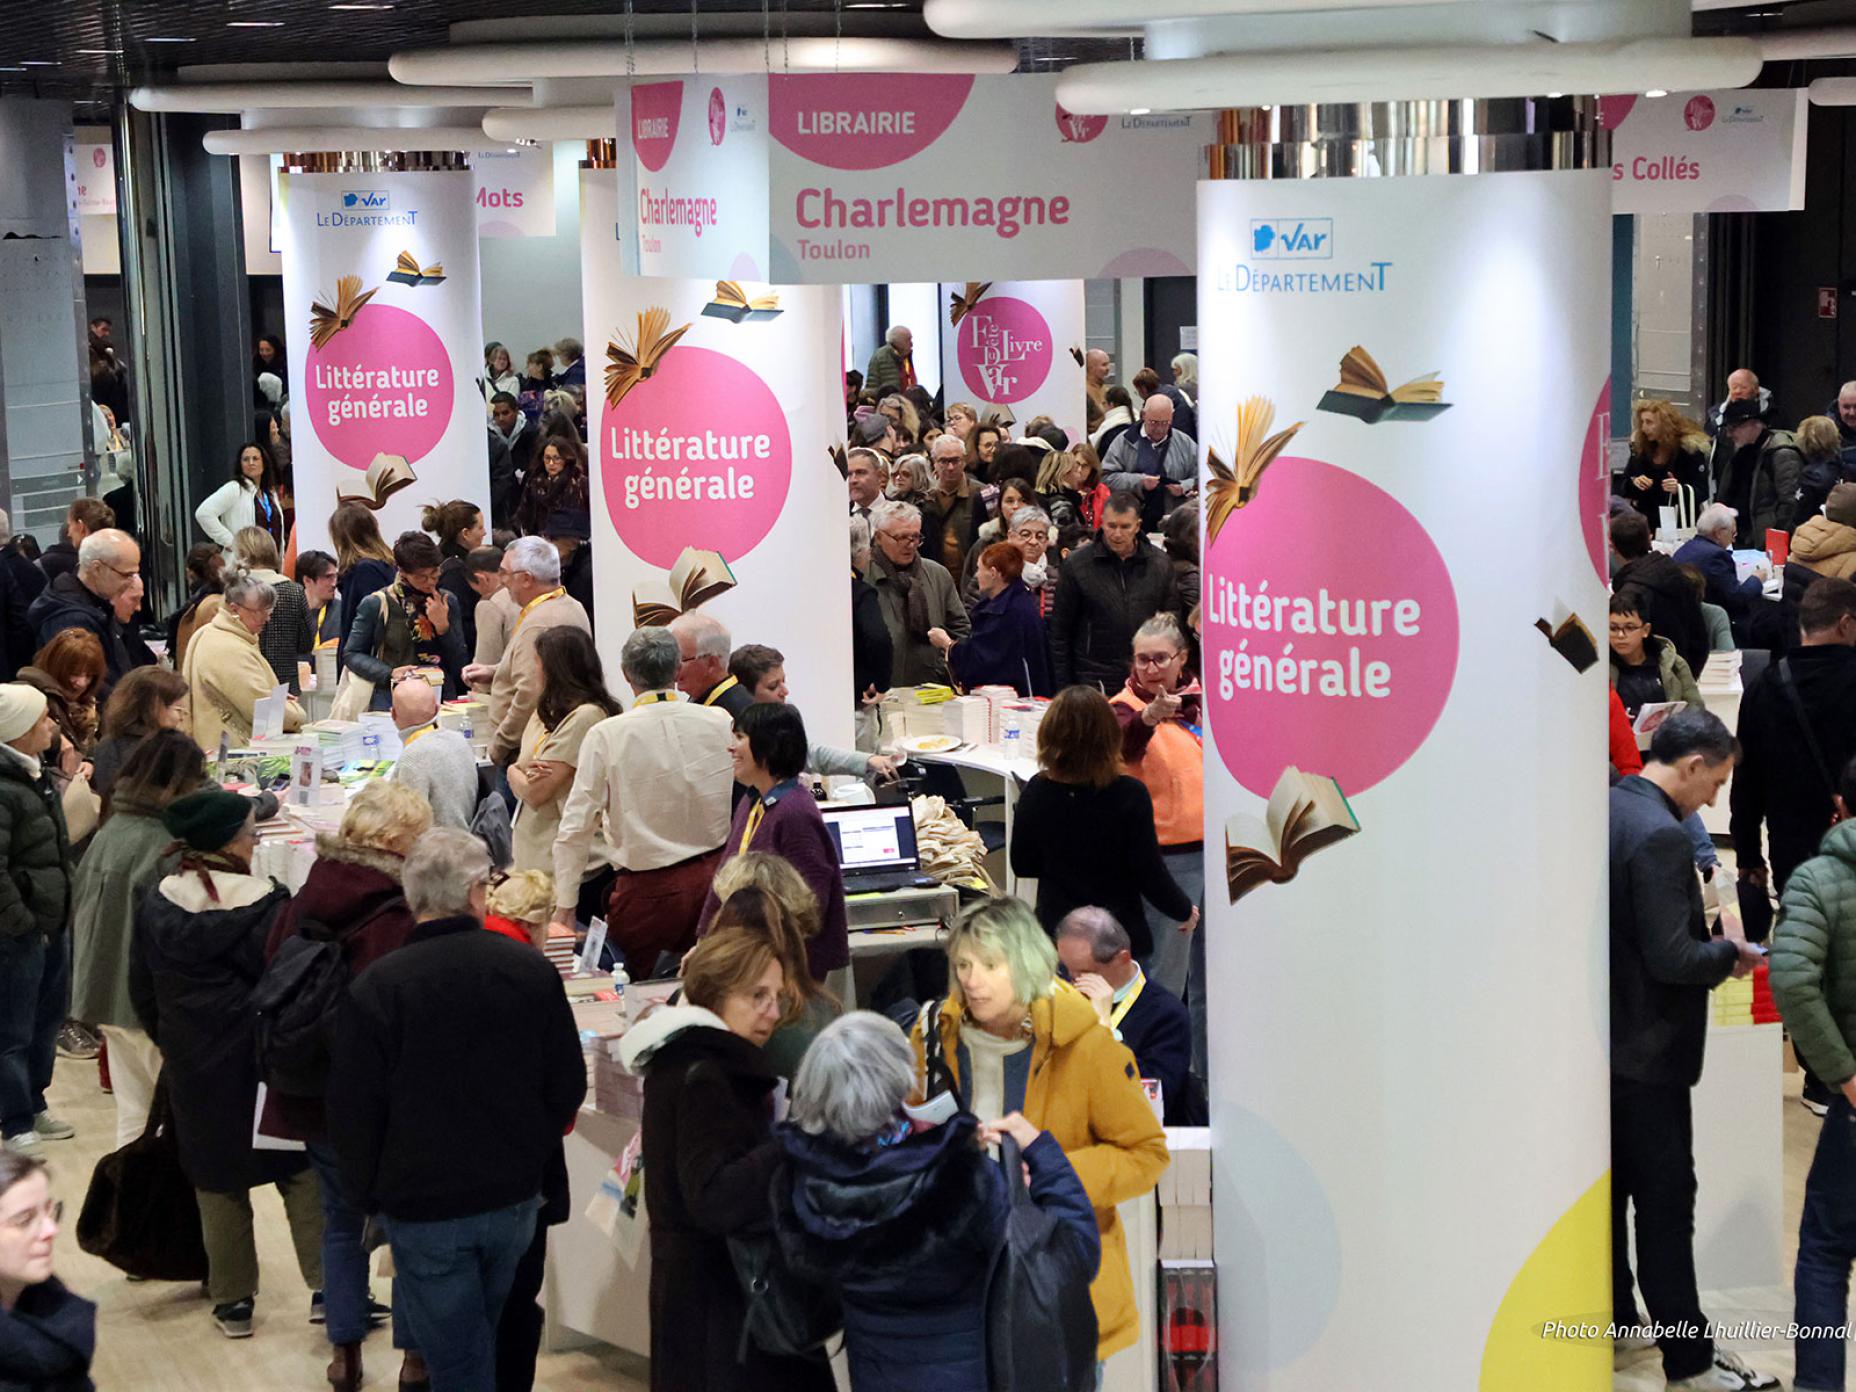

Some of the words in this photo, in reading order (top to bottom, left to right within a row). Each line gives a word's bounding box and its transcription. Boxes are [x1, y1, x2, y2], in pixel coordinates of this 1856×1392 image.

[797, 111, 916, 135] LIBRAIRIE
[1632, 155, 1700, 181] Collés
[640, 187, 717, 238] Charlemagne
[795, 187, 1070, 239] Charlemagne
[797, 239, 871, 260] Toulon
[1235, 261, 1393, 293] DÉPARTEMENT
[316, 364, 440, 390] Littérature
[327, 393, 429, 427] générale
[610, 426, 771, 461] Littérature
[624, 466, 754, 509] générale
[1208, 573, 1421, 637] Littérature
[1219, 638, 1392, 701] générale
